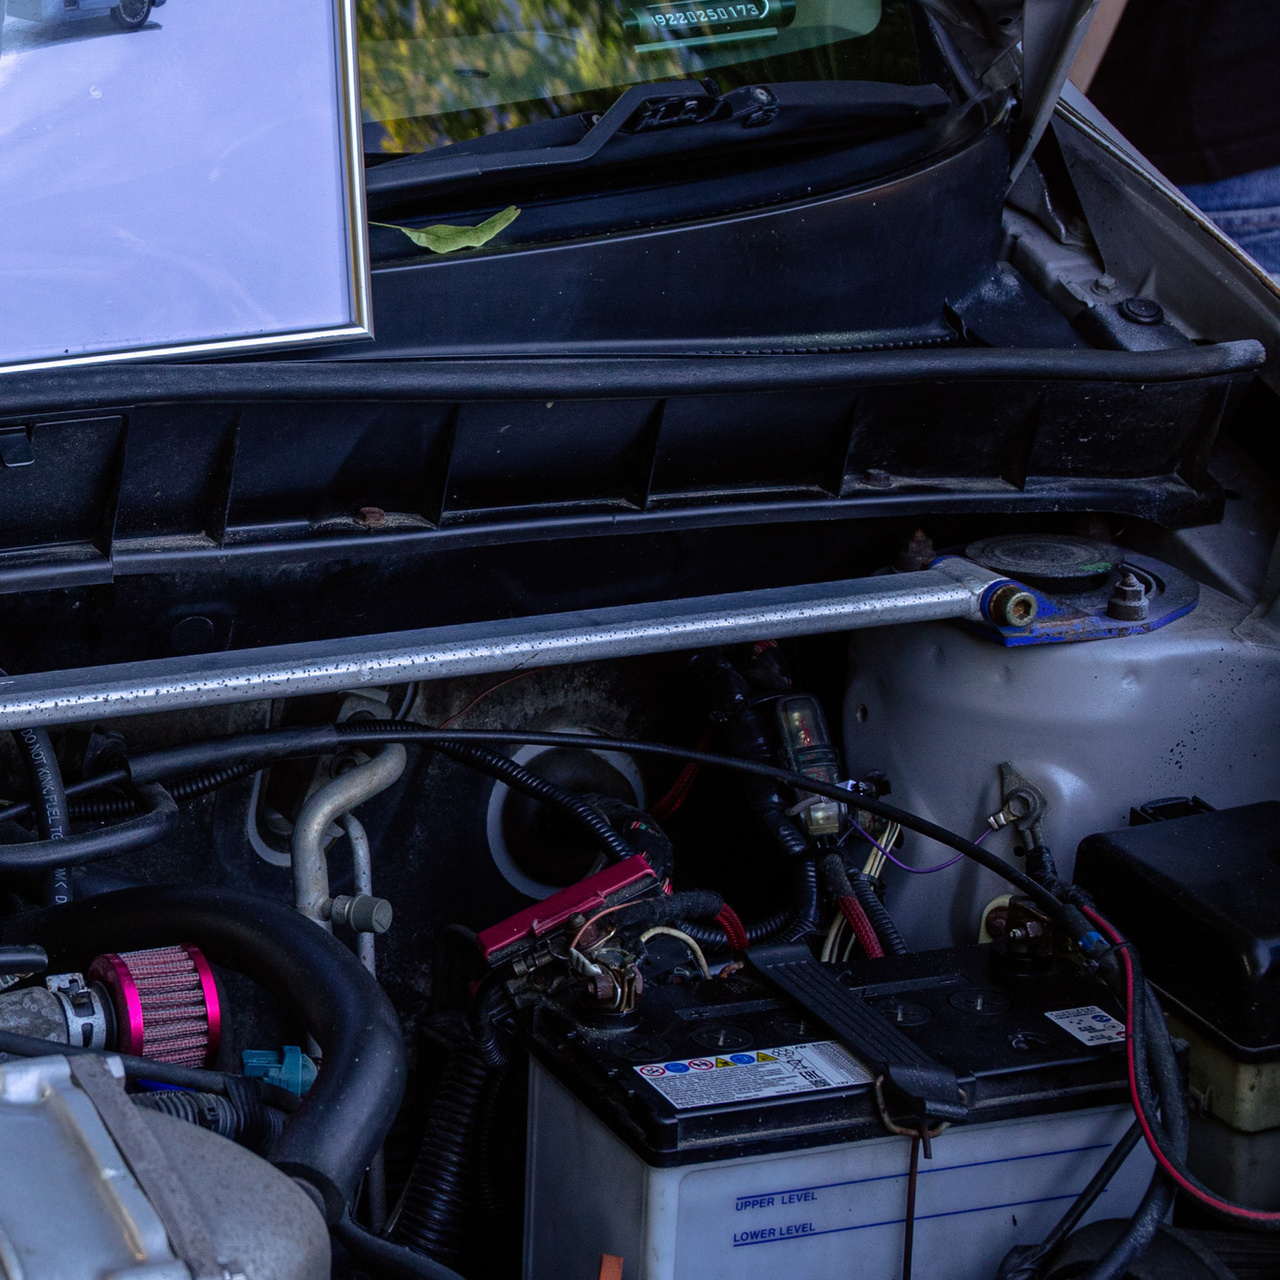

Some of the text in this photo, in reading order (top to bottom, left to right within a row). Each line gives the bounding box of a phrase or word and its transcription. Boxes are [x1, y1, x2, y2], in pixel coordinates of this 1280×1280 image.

[20, 728, 37, 744] DO
[28, 743, 47, 765] NOT
[44, 794, 61, 824] FUEL
[735, 1191, 818, 1211] UPPER LEVEL
[733, 1222, 816, 1243] LOWER LEVEL
